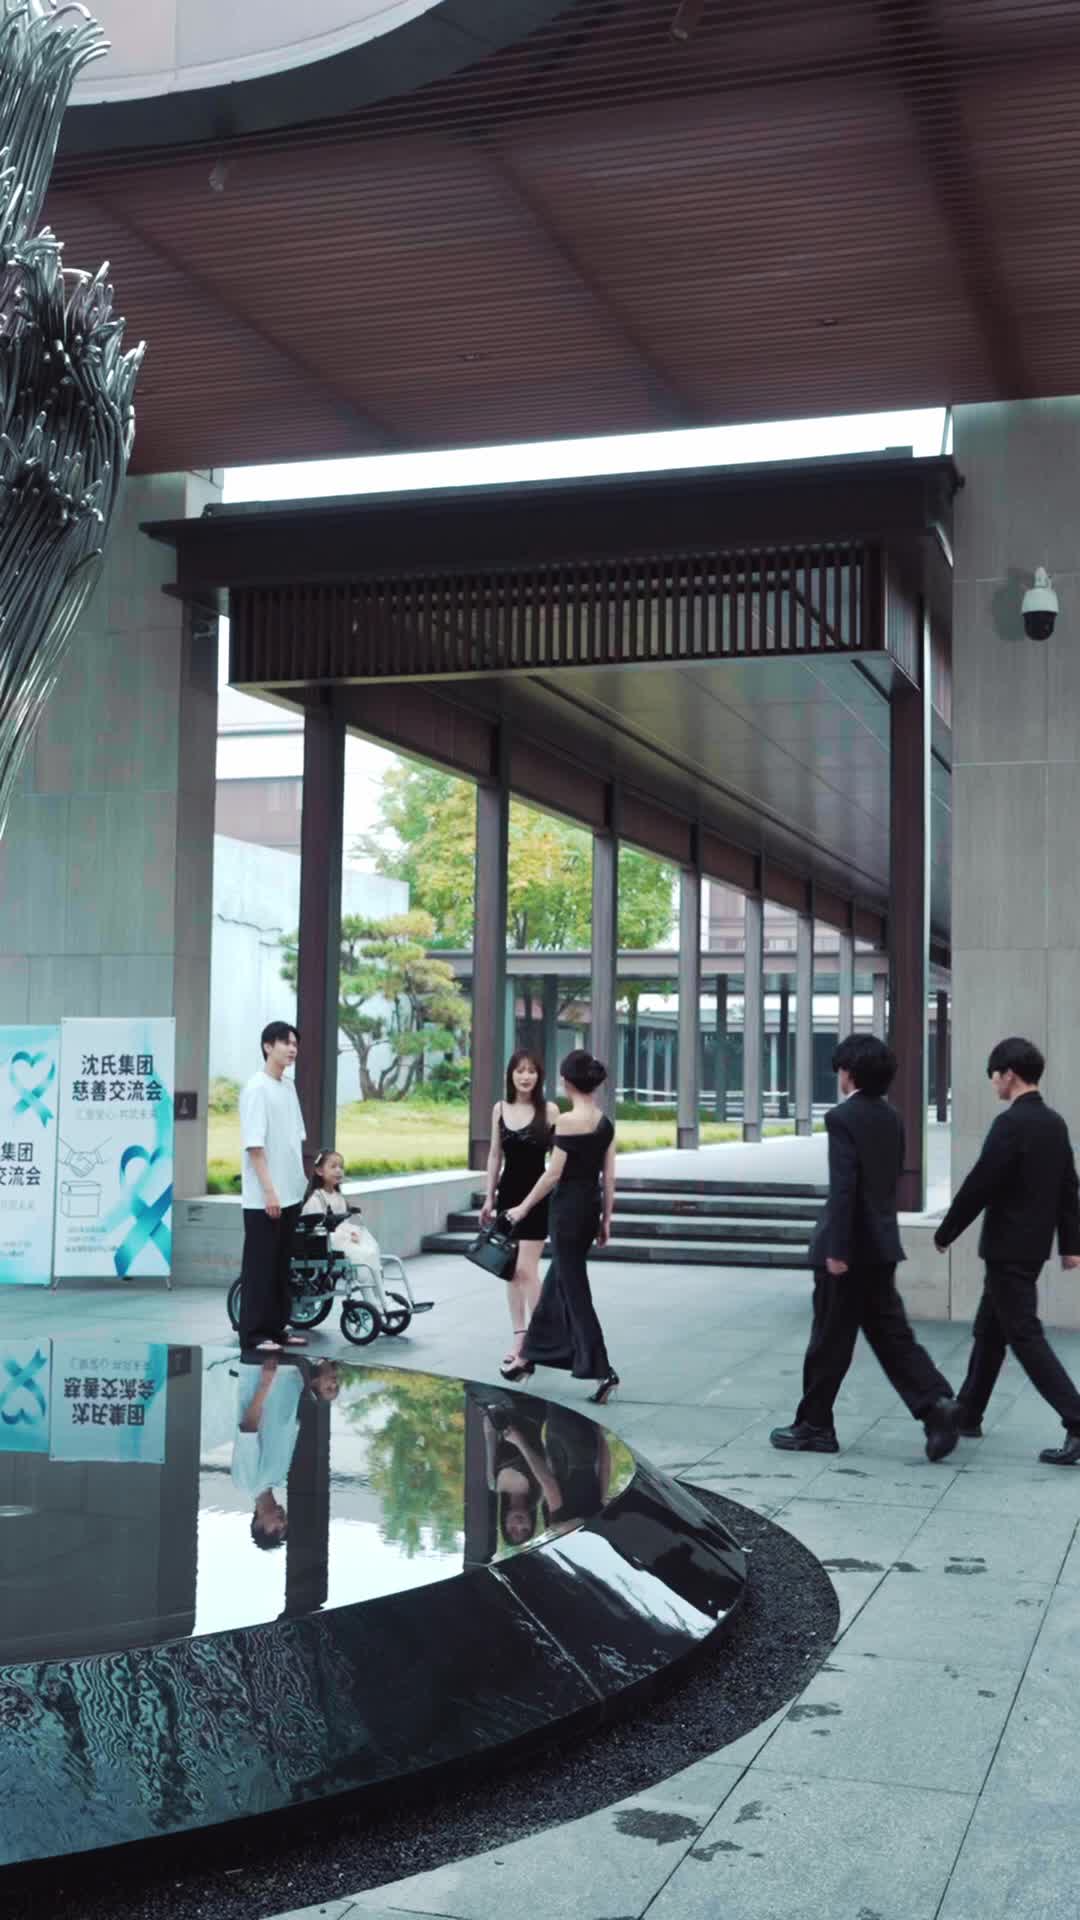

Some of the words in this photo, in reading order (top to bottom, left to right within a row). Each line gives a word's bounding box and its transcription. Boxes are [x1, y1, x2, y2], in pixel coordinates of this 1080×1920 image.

[81, 1054, 154, 1076] 沈氏集团
[72, 1080, 163, 1101] 慈善交流会
